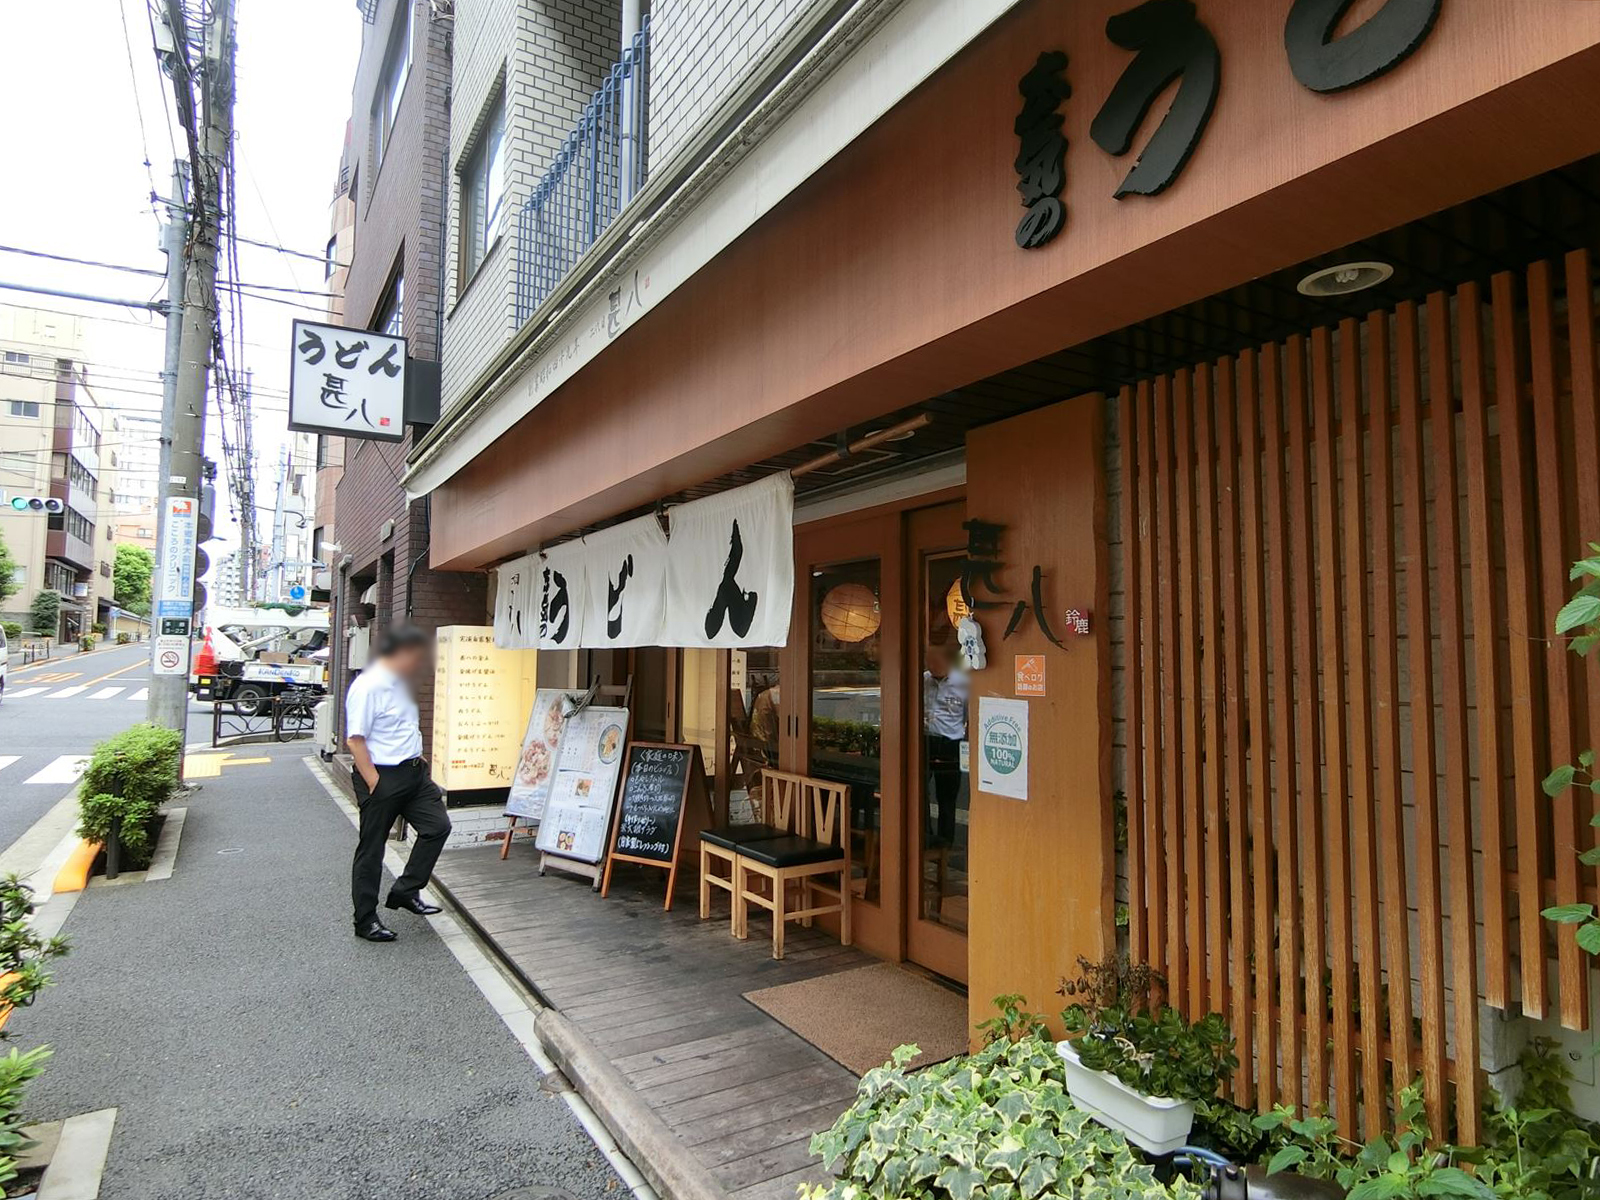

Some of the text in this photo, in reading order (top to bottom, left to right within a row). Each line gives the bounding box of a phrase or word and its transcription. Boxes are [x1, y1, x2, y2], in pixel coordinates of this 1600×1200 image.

[298, 329, 402, 378] うどん
[320, 373, 375, 428] 甚八
[959, 517, 1069, 651] 甚八
[1065, 609, 1089, 634] 鈴鹿
[1017, 671, 1044, 682] 食べログ
[983, 712, 1022, 733] Additive Free
[989, 731, 1017, 746] 無添加
[990, 758, 1016, 769] NATURAL
[991, 748, 1015, 761] 100%
